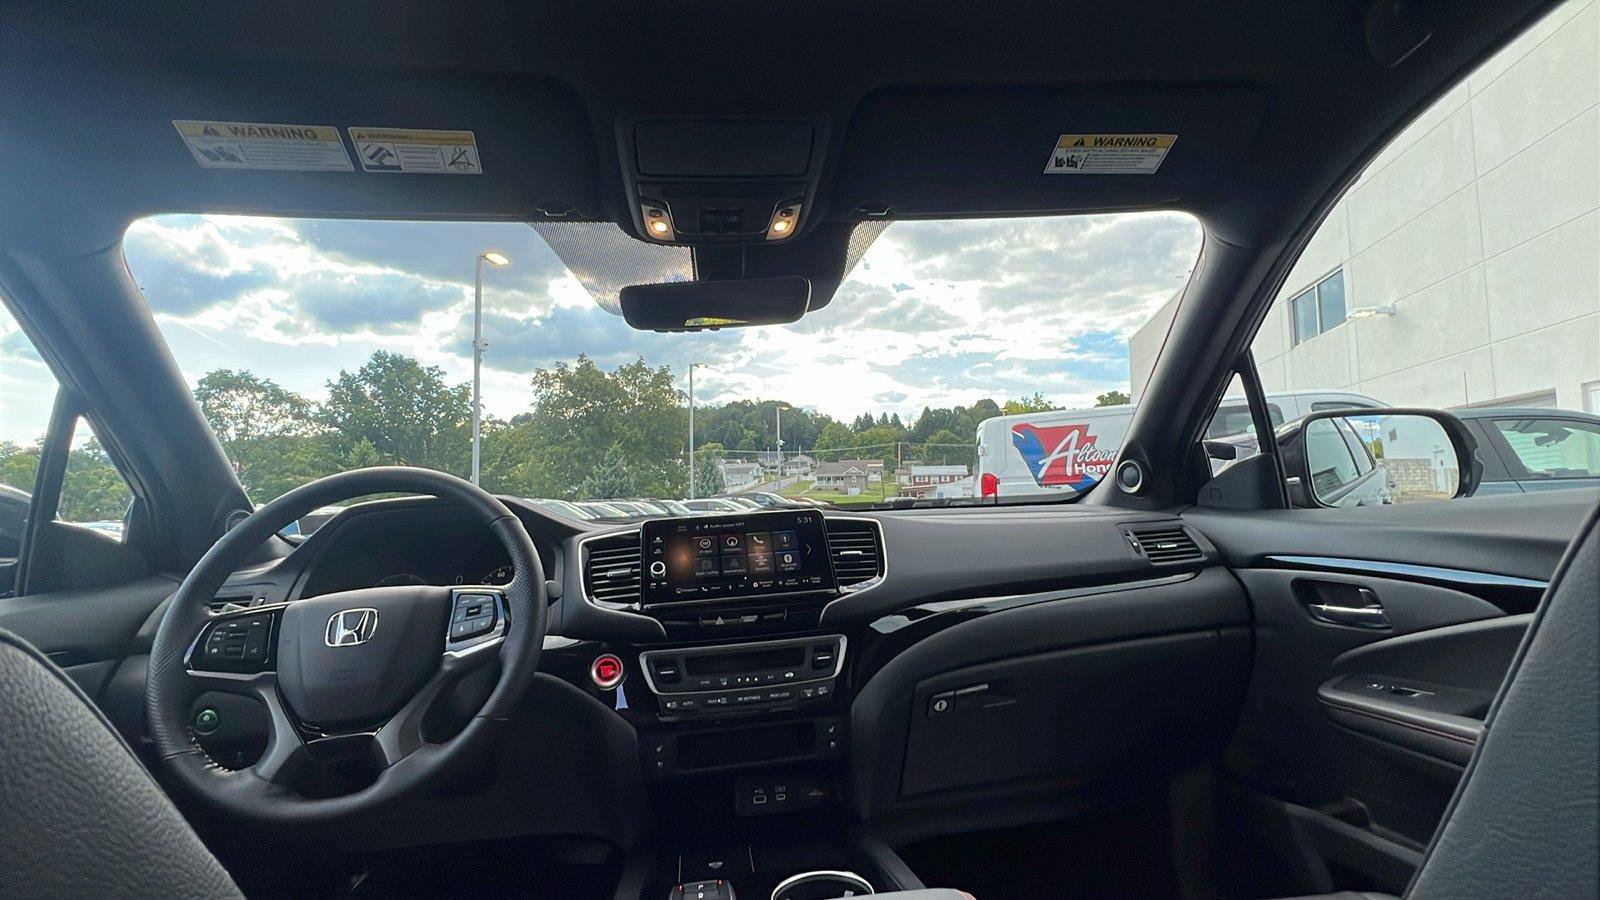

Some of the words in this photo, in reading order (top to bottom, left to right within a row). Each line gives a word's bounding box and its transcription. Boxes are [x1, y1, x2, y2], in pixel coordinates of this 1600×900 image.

[228, 125, 318, 139] WARNING
[1093, 136, 1158, 148] WARNING
[1038, 429, 1117, 479] Altoon
[796, 516, 812, 524] 5:31
